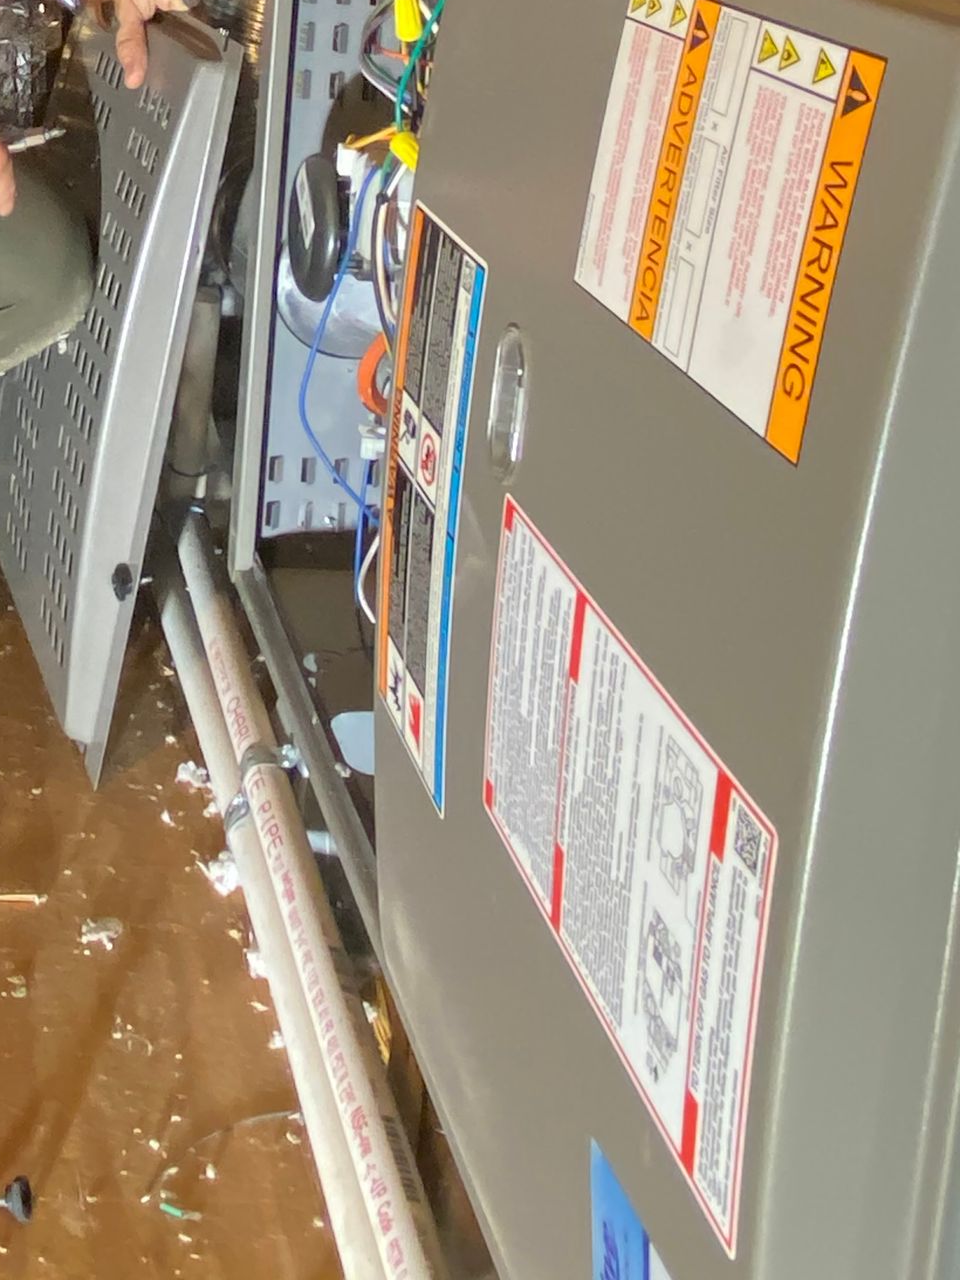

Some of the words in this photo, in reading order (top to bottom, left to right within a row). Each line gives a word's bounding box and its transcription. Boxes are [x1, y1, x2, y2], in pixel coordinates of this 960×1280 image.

[718, 145, 728, 167] Air
[634, 69, 698, 322] ADVERTENCIA
[782, 159, 854, 403] WARNING
[224, 696, 266, 795] CHARLTE
[254, 800, 284, 857] PIPE
[703, 860, 721, 944] APPLIANCE
[697, 966, 709, 1000] GAS
[694, 999, 706, 1030] OFF
[690, 1032, 702, 1070] TURN
